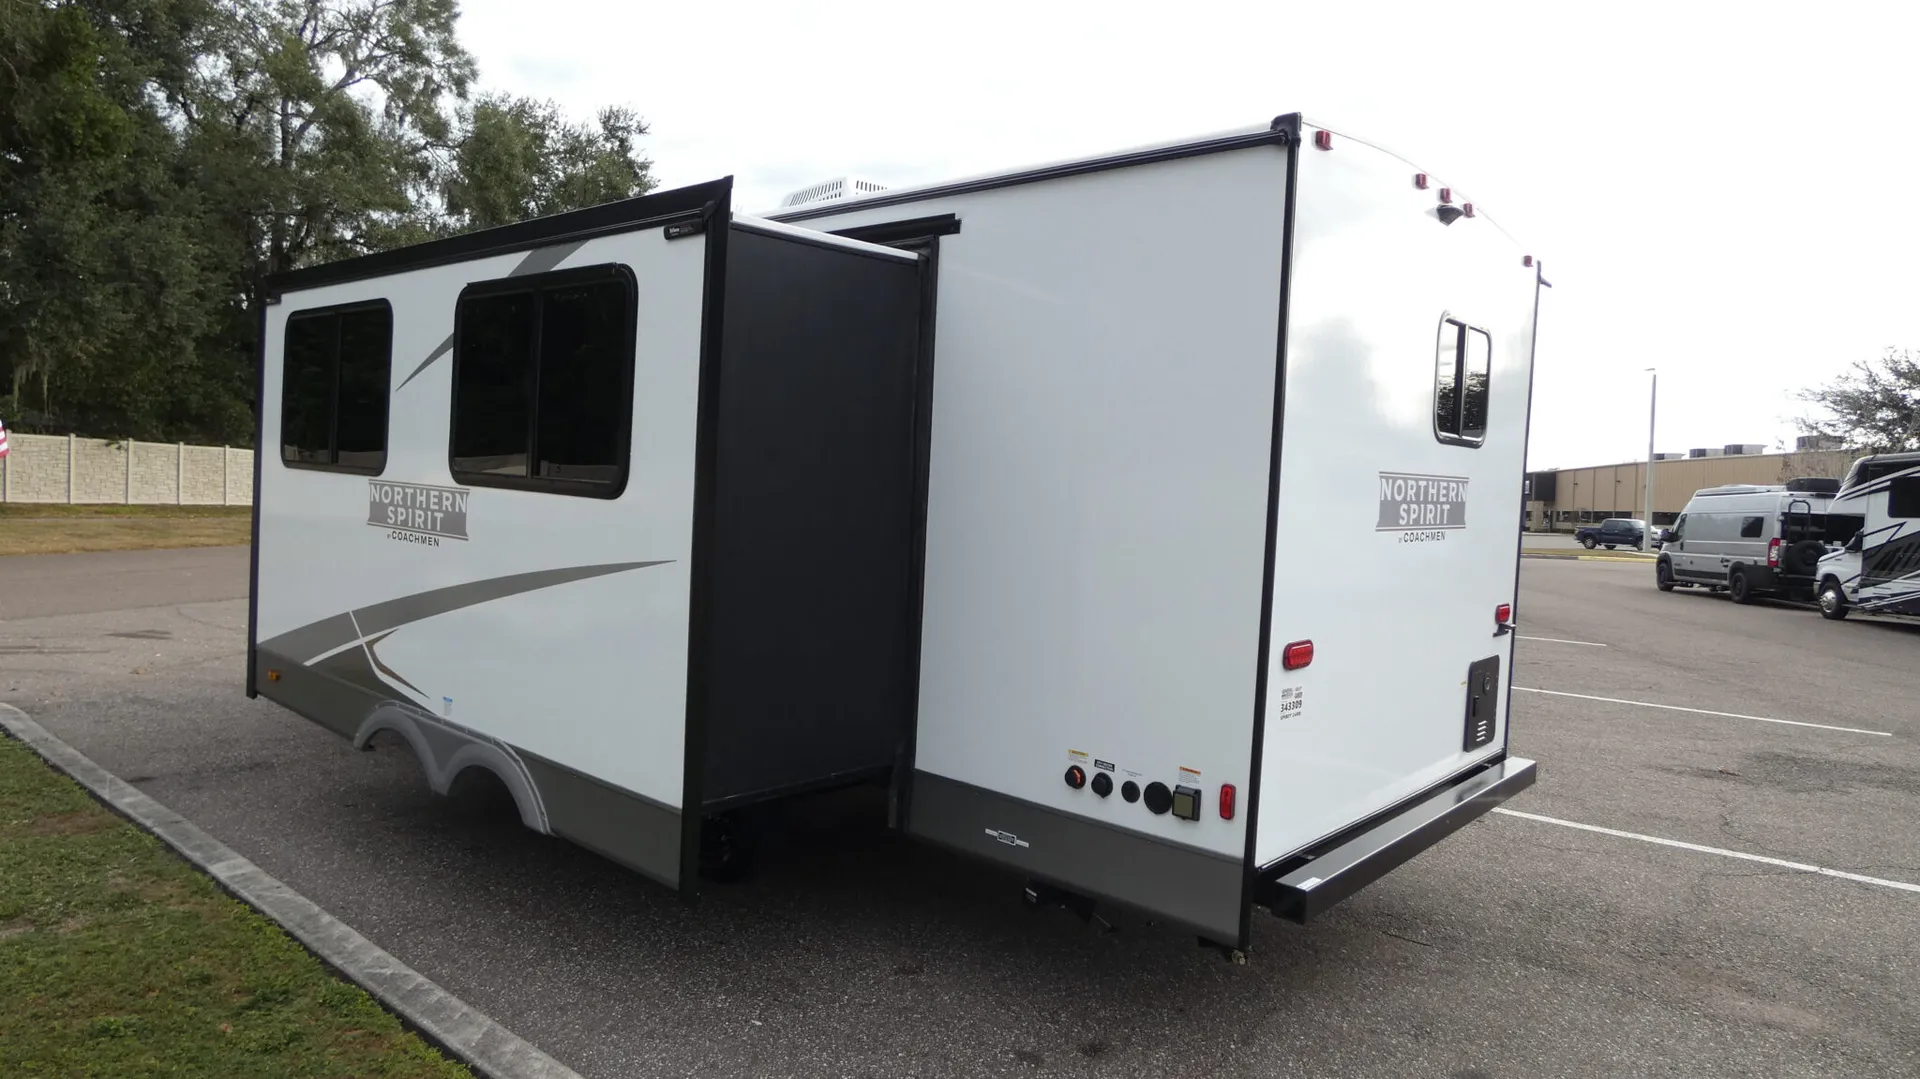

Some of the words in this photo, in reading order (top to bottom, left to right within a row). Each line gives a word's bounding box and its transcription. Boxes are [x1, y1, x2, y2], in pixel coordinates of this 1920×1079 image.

[370, 484, 467, 513] NORTHERN
[1380, 478, 1467, 502] NORTHERN
[387, 506, 444, 531] SPIRIT
[1398, 503, 1451, 525] SPIRIT
[391, 530, 440, 547] COACHMEN
[1403, 530, 1446, 543] COACHMEN
[1280, 699, 1303, 713] 343309
